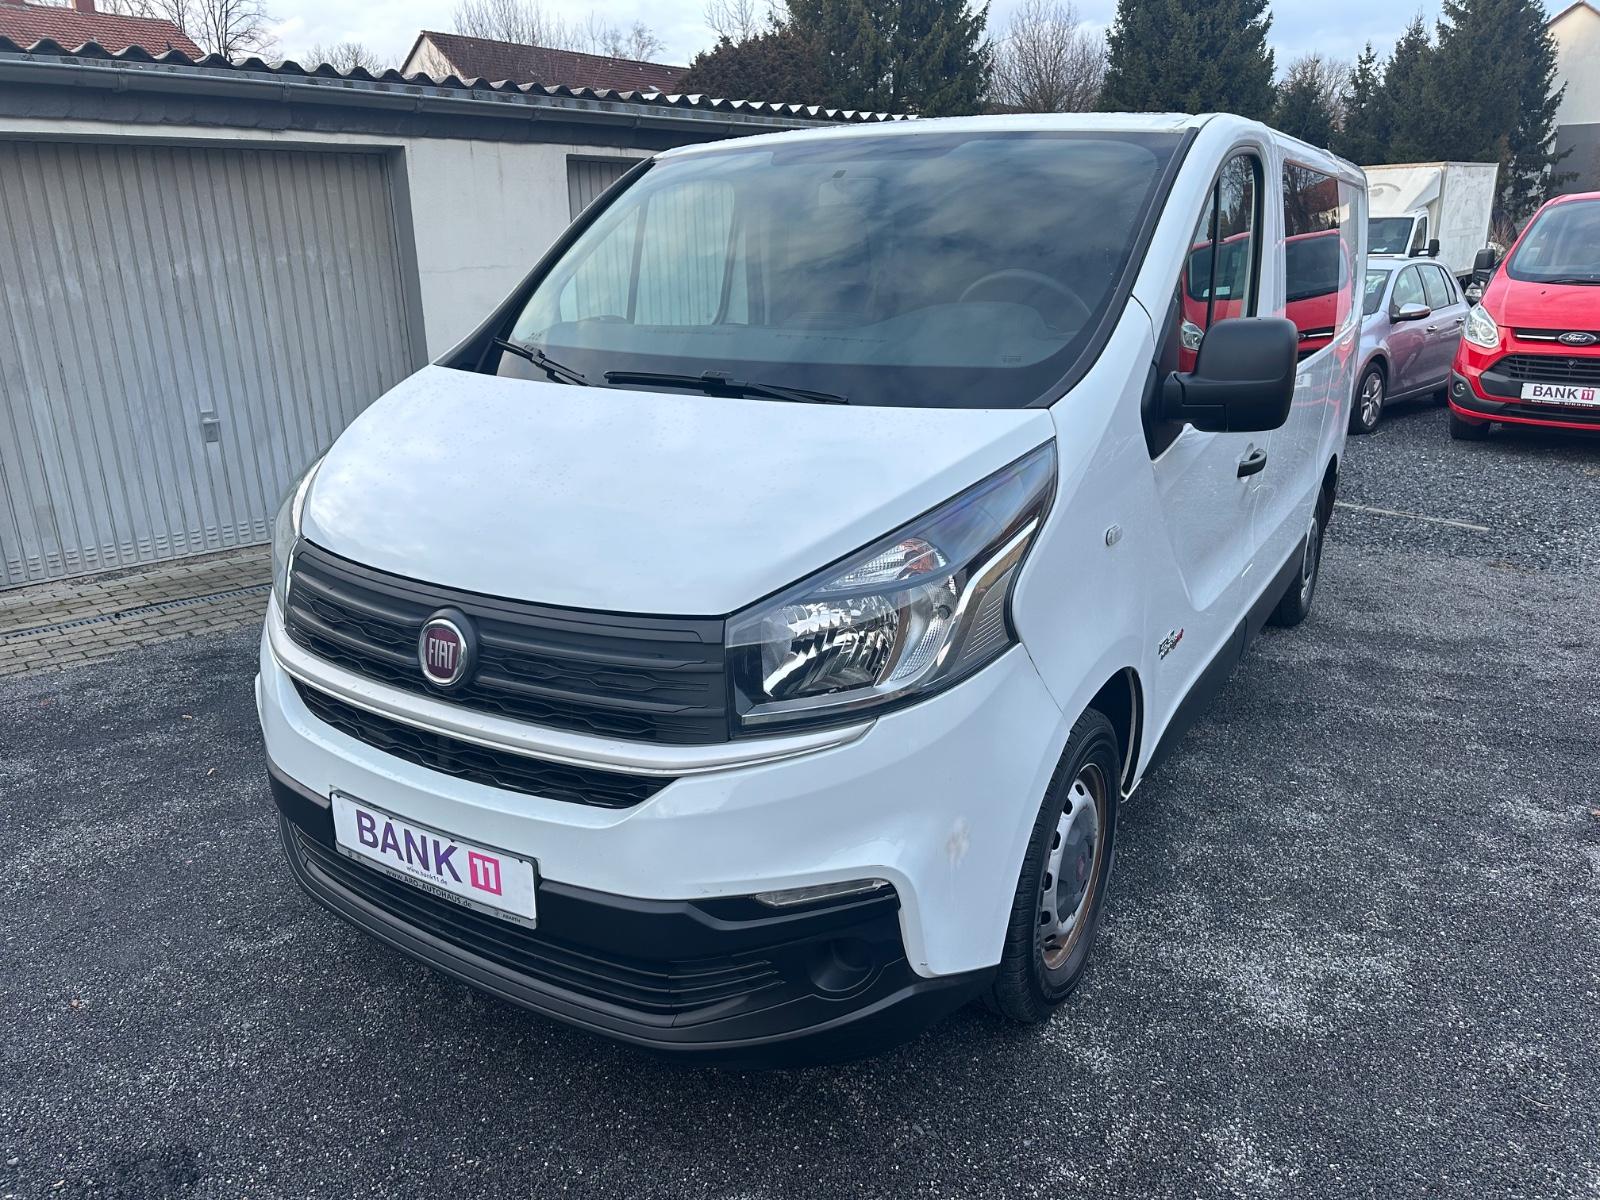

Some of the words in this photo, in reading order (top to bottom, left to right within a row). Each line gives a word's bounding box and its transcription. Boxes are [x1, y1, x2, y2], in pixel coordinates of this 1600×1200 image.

[1533, 386, 1579, 400] BANK
[1582, 390, 1594, 400] 11
[428, 637, 456, 670] FIAT
[356, 809, 462, 883] BANK
[471, 856, 498, 891] 11
